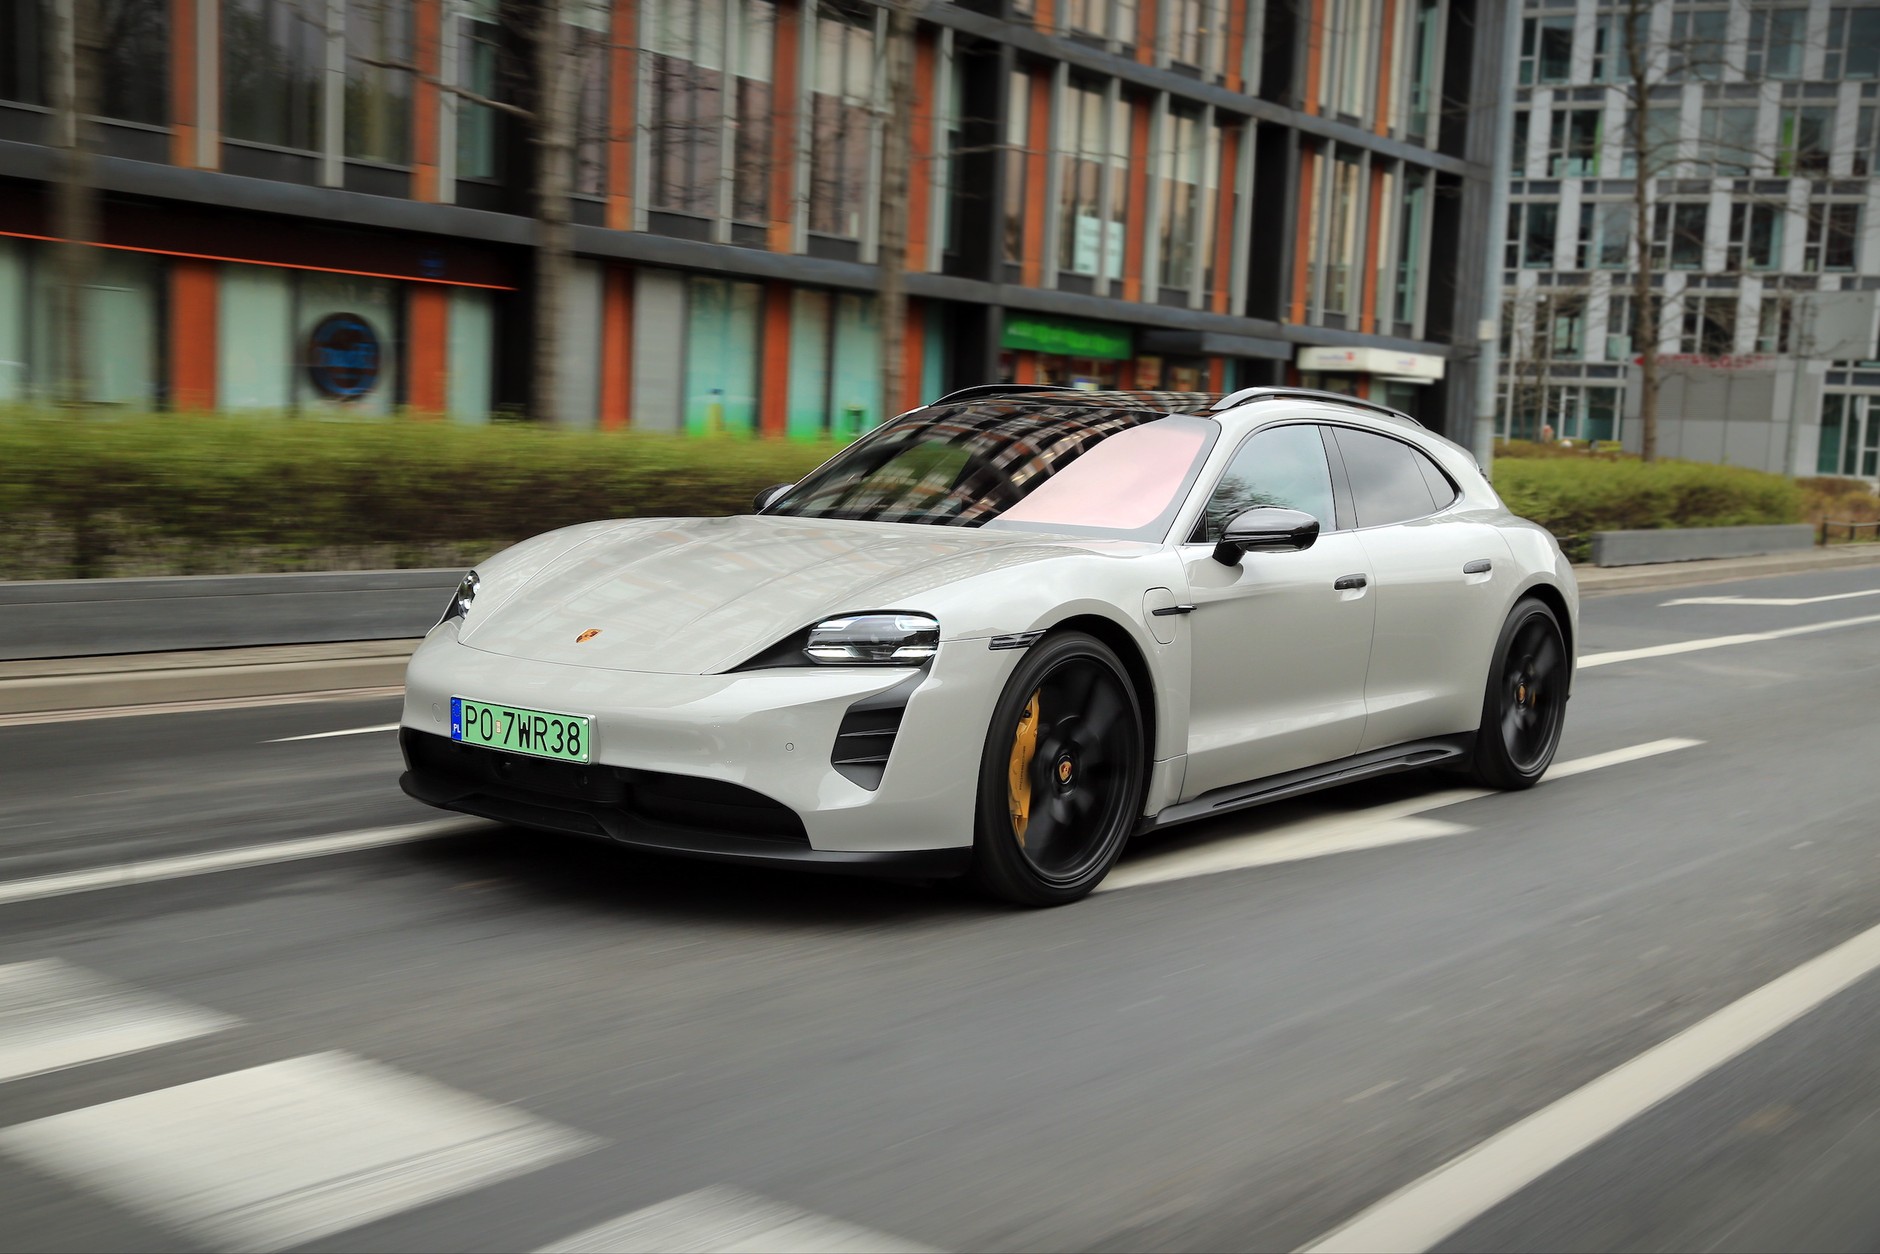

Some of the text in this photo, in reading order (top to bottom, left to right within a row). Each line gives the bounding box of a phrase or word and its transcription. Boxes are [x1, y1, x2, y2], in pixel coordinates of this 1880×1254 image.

[453, 723, 461, 734] PL
[465, 704, 580, 755] PO 7WR38
